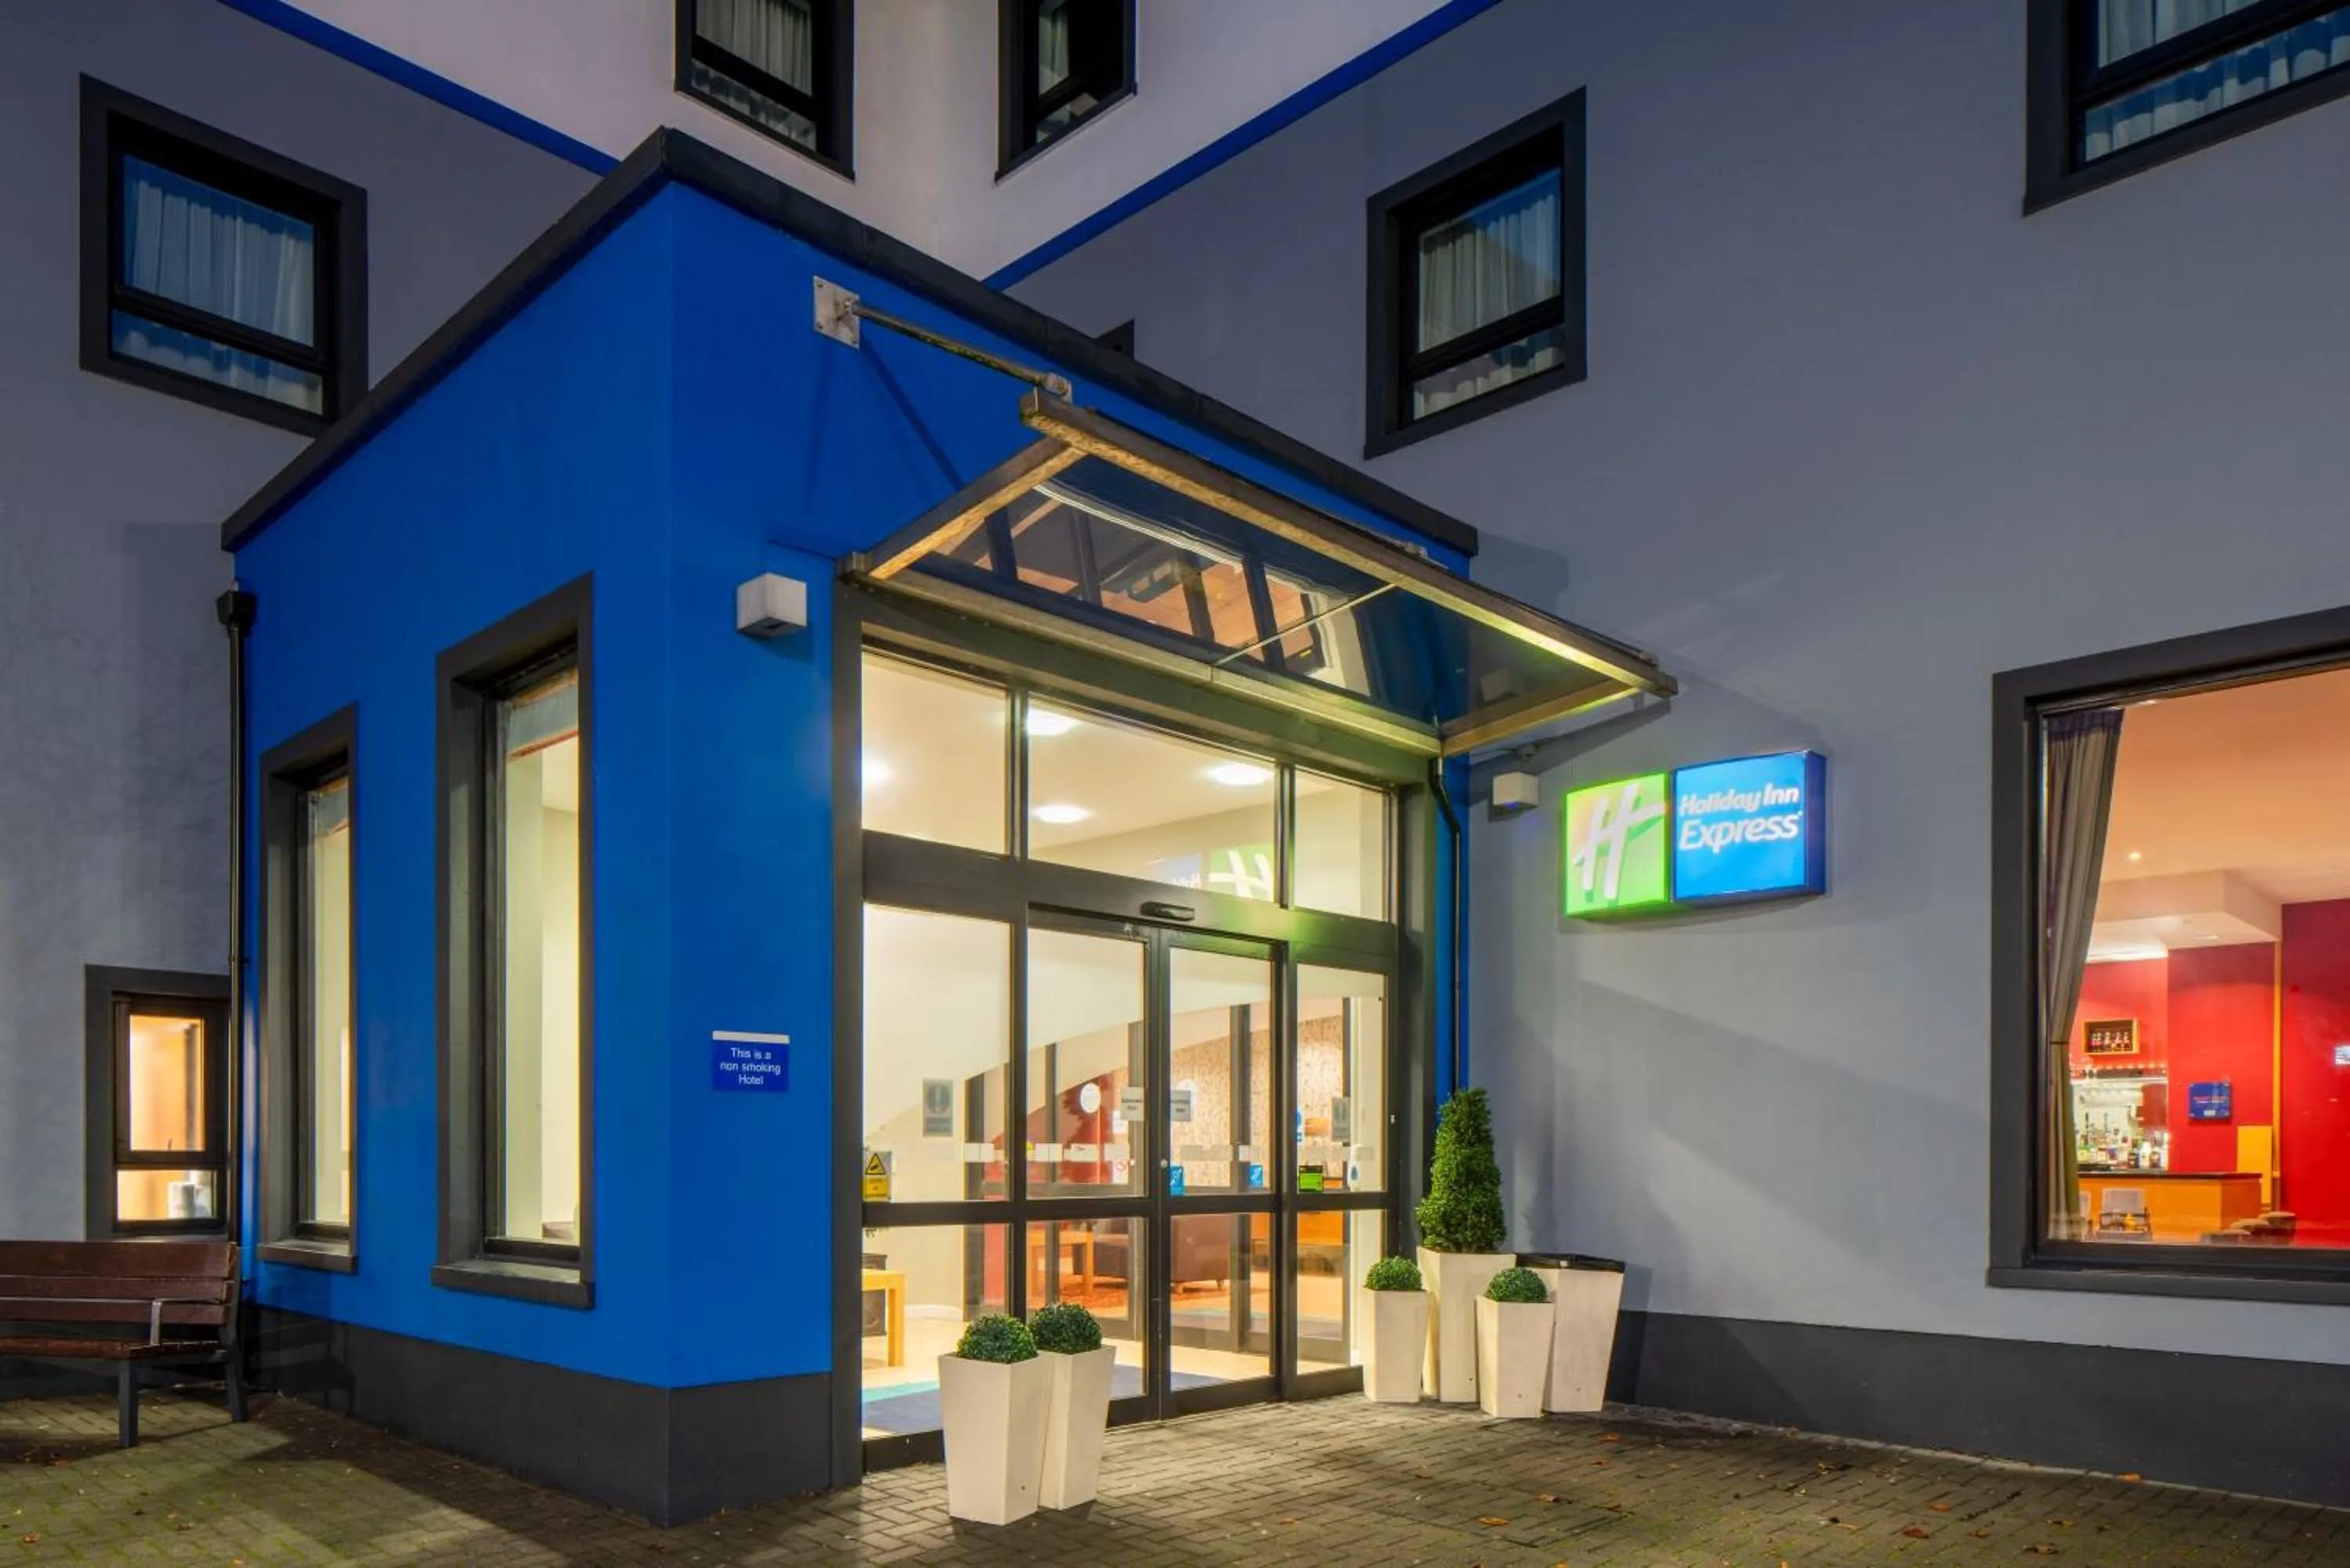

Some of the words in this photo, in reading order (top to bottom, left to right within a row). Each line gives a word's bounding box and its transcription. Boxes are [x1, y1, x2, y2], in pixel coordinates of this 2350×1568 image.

[1679, 788, 1762, 817] Holiday
[1763, 782, 1800, 806] Inn
[1679, 812, 1801, 854] Express
[729, 1047, 751, 1059] This
[754, 1050, 762, 1060] is
[720, 1061, 739, 1071] non
[741, 1061, 781, 1075] smoking
[739, 1074, 764, 1085] Hotel
